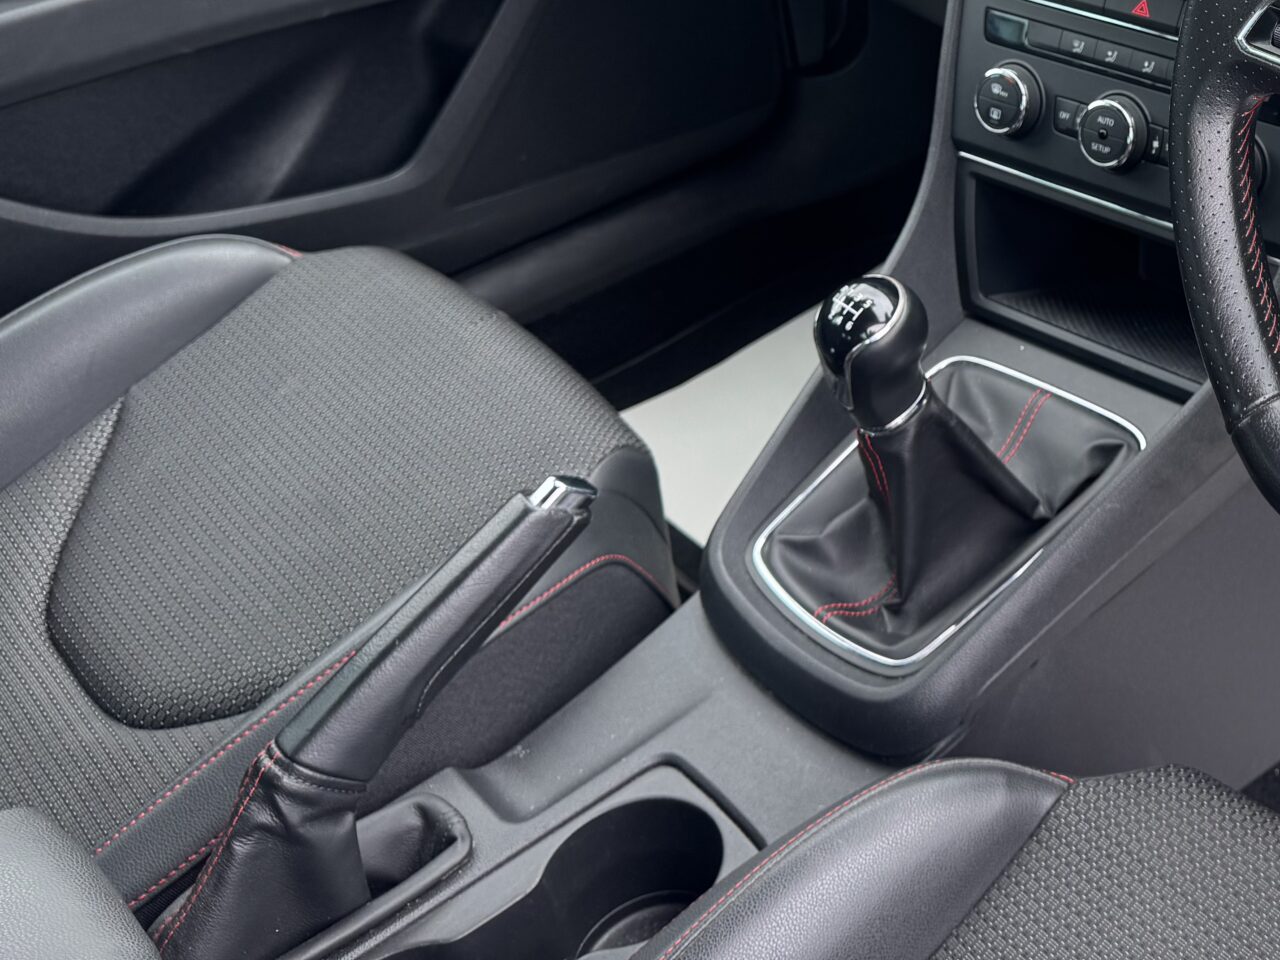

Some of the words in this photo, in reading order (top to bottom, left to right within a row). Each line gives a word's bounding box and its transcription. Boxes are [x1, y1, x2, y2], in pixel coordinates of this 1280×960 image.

[1060, 111, 1071, 121] OFF
[1098, 115, 1115, 127] AUTO
[1091, 142, 1112, 154] SETUP
